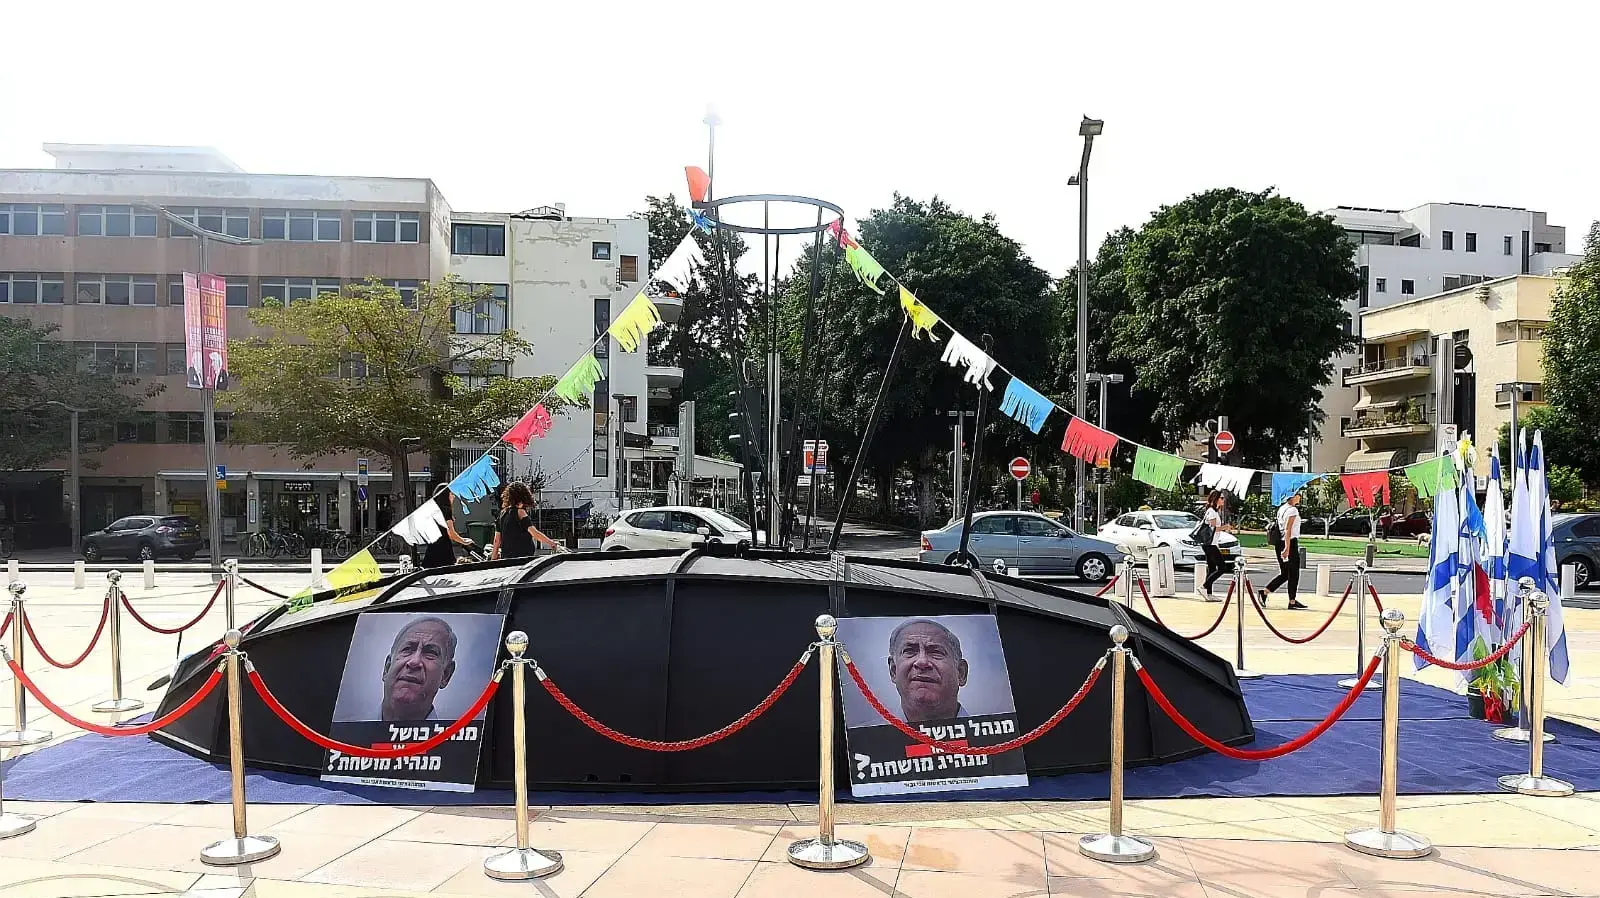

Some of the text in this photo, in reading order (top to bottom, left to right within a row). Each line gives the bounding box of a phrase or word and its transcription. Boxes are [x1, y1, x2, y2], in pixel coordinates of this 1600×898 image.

[388, 723, 478, 742] מנל כושל
[919, 719, 1015, 740] מנהל כושל
[327, 749, 442, 771] מנהיג מושחת?
[854, 753, 988, 780] מנהיג מושחת?
